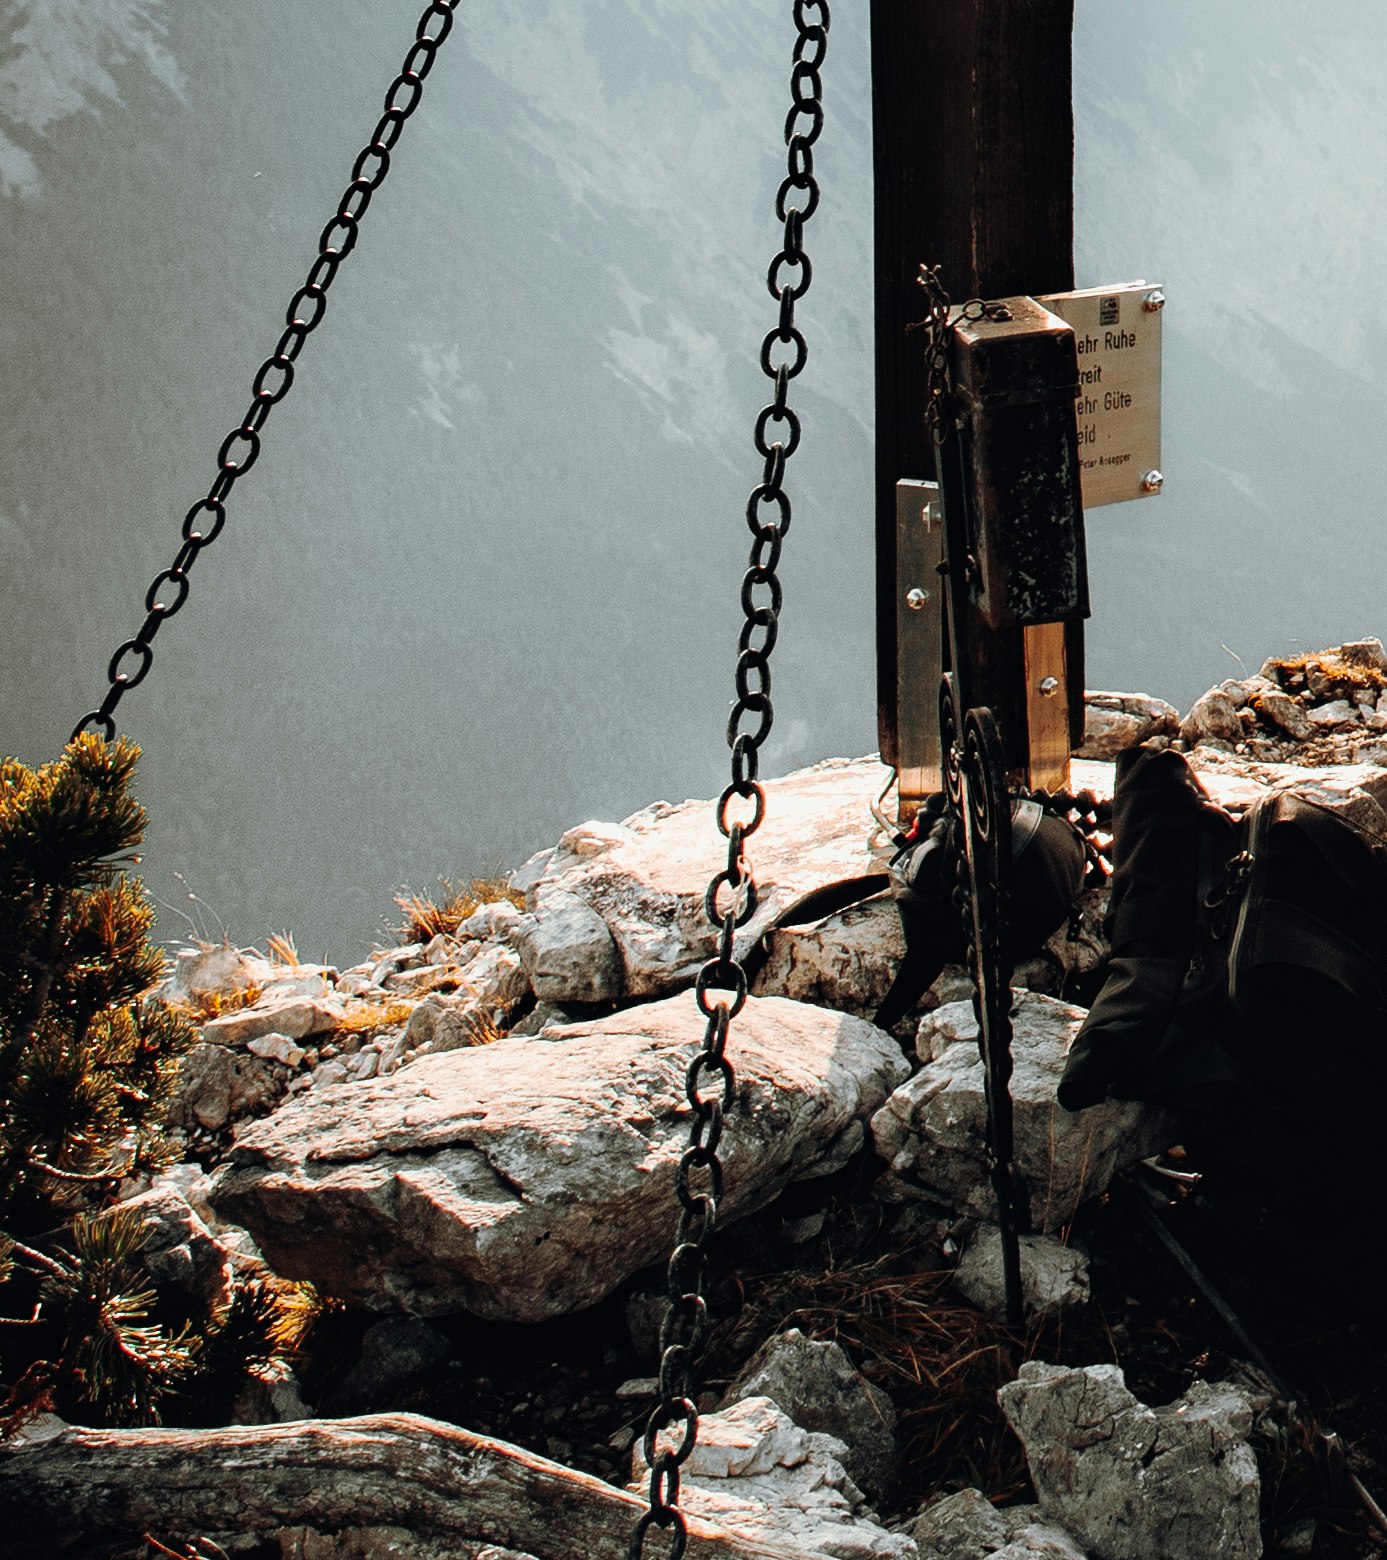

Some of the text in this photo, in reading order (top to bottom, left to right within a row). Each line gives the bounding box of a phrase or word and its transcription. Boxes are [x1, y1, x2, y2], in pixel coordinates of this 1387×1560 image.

[1077, 329, 1136, 354] ehr Ruhe
[1077, 391, 1132, 415] ehr Güte
[1077, 424, 1096, 445] eid
